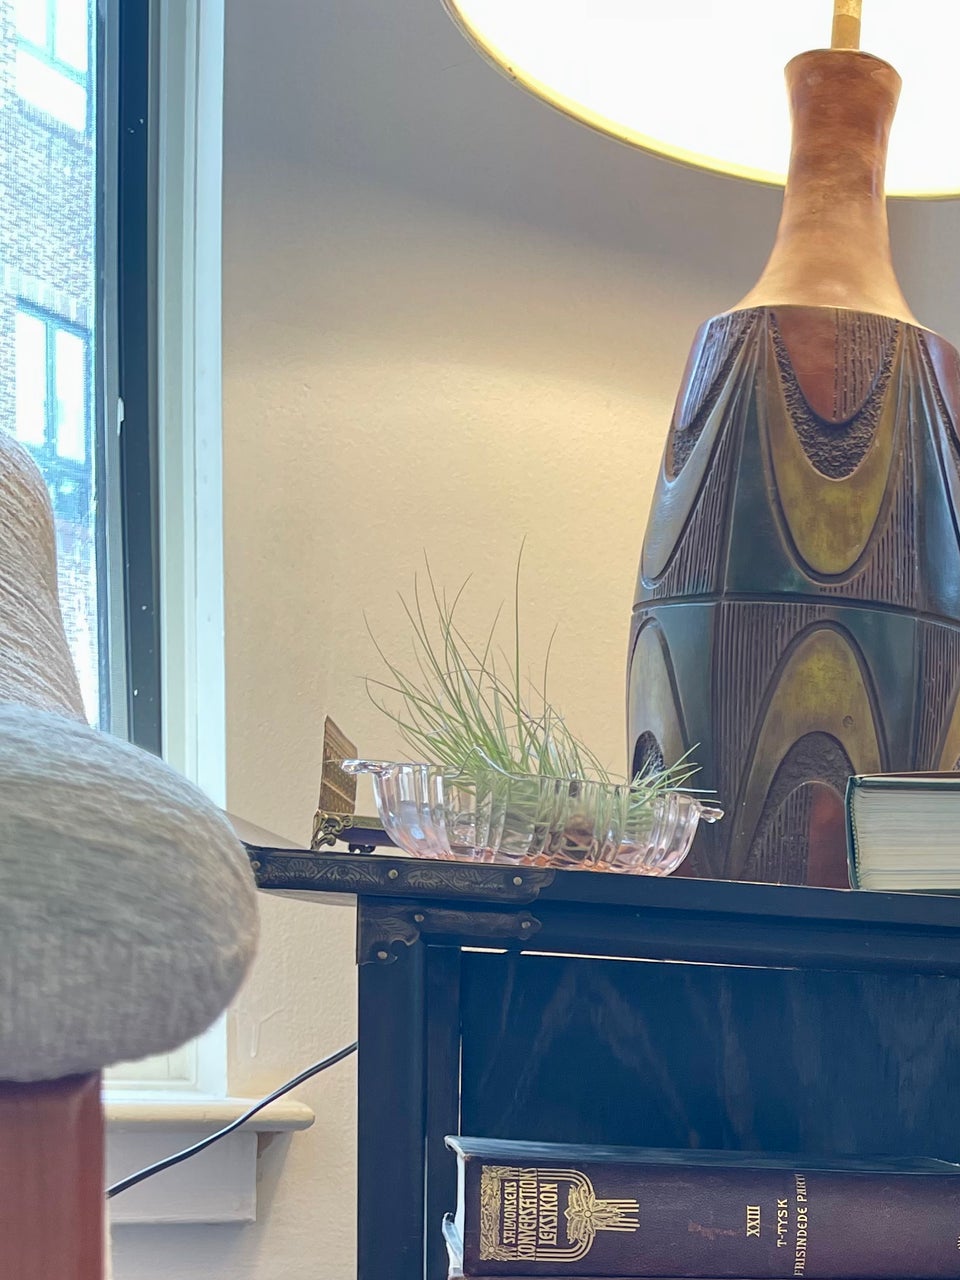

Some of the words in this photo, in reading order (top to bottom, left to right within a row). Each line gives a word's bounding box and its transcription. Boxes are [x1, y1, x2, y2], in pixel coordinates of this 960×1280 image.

[504, 1181, 517, 1244] SALMONSENS
[517, 1168, 538, 1260] KONVERSATIONS
[538, 1183, 558, 1246] LEKSIKON
[746, 1205, 760, 1237] XXIII
[777, 1199, 788, 1247] T-TYSK
[794, 1207, 808, 1276] FRISINDEDE
